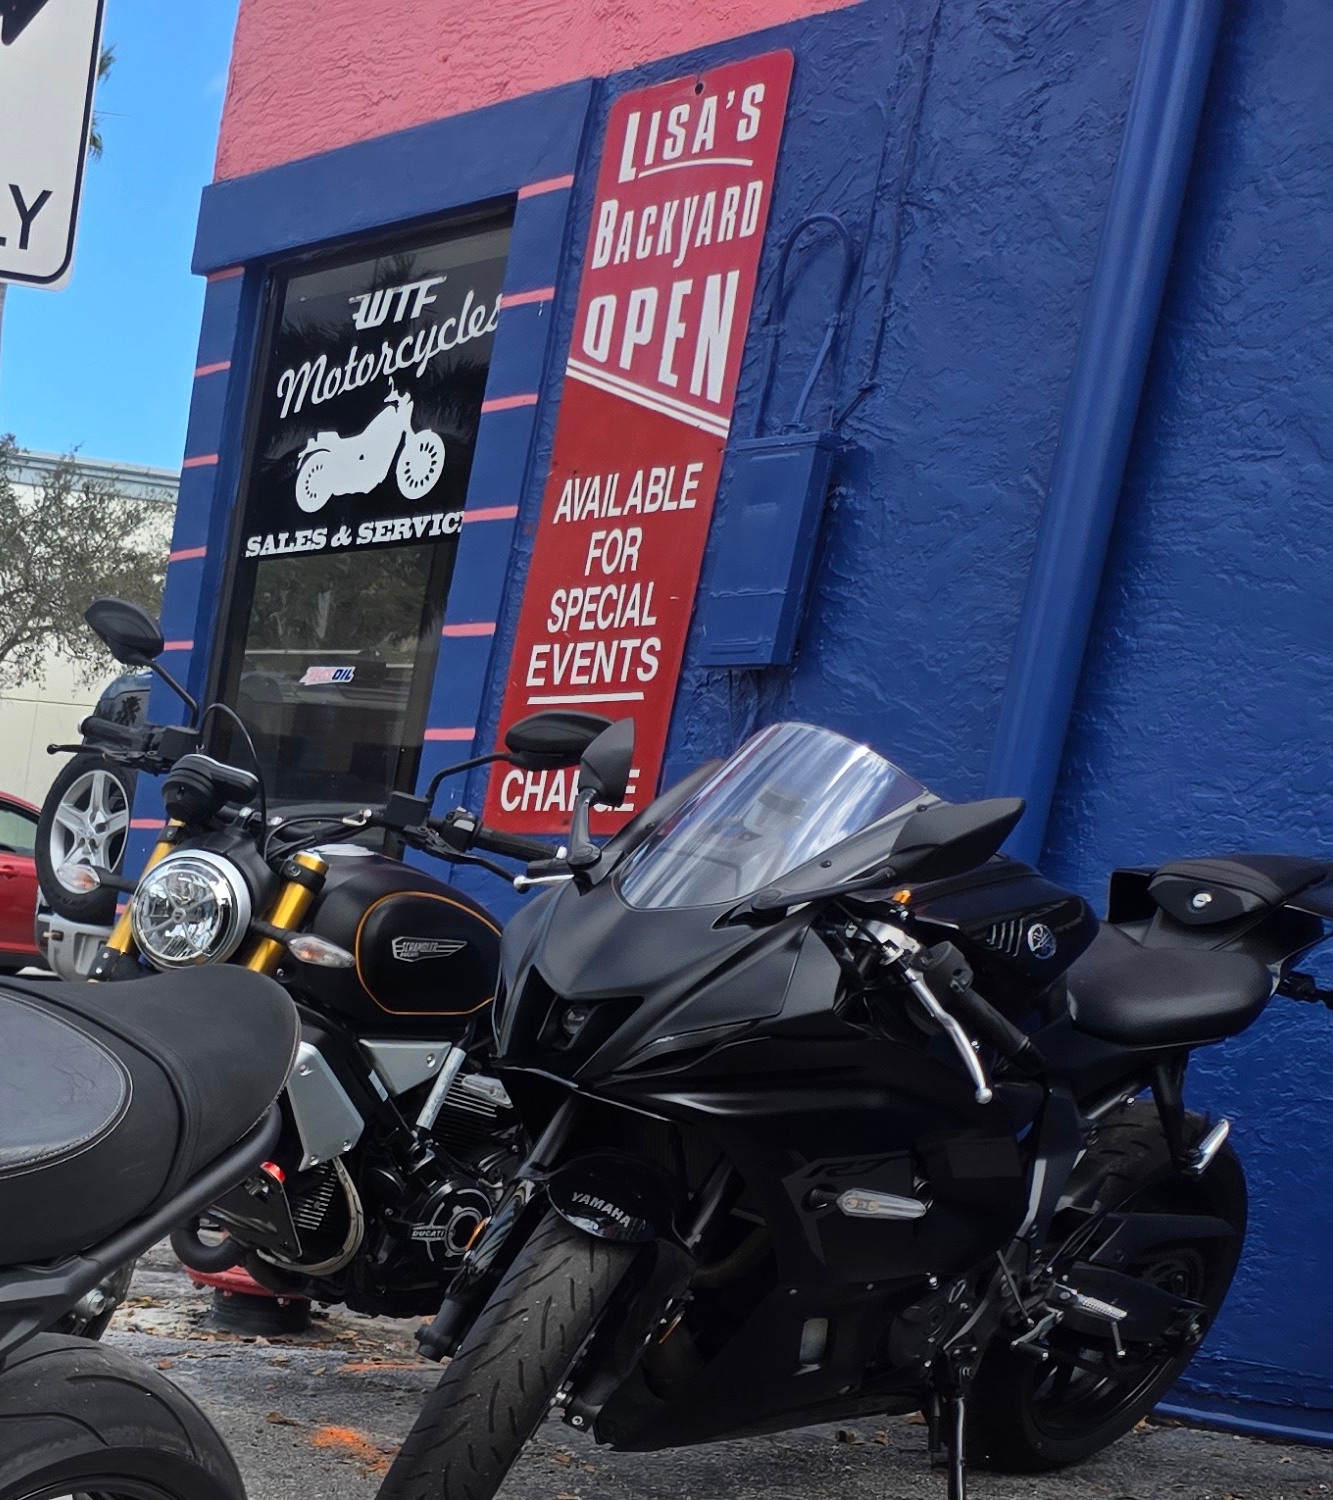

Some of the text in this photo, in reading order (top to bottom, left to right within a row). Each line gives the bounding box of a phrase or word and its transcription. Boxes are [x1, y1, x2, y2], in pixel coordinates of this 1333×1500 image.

[618, 83, 765, 183] LISA'S
[349, 275, 447, 330] WTF
[276, 289, 504, 419] Motorcycles
[582, 269, 740, 404] OPEN
[552, 462, 704, 524] AVAILABLE
[245, 510, 465, 558] SALES & SERVIC
[584, 527, 643, 577] FOR
[547, 581, 658, 633] SPECIAL
[307, 667, 353, 681] OIL
[526, 637, 661, 687] EVENTS
[500, 769, 641, 812] CHAE
[571, 1191, 631, 1228] YAMAHA
